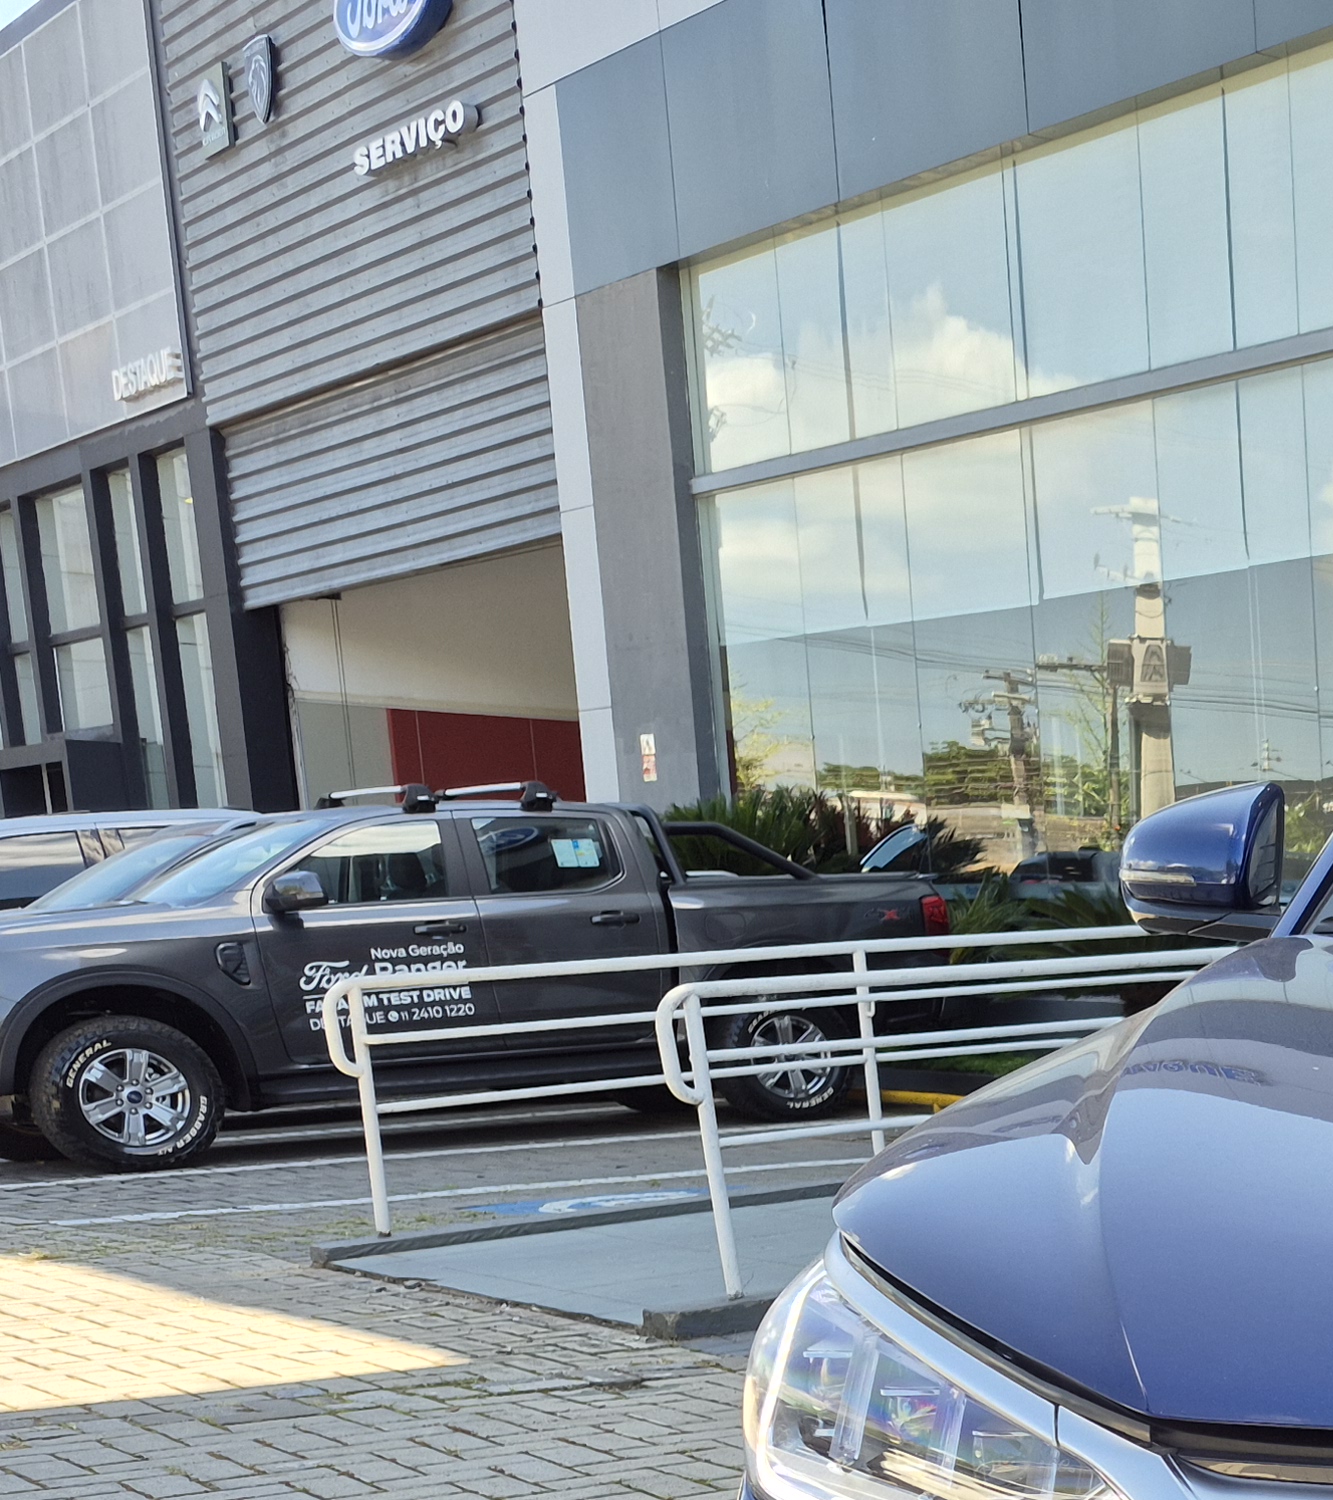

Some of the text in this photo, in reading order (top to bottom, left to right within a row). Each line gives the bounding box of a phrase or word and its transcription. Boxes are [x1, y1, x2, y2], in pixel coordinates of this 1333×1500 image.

[354, 99, 465, 176] SERVIÇO
[112, 346, 182, 401] DESTAQUE
[370, 942, 465, 960] Nova Geração
[305, 996, 350, 1014] FAA
[379, 990, 417, 1006] TEST
[419, 986, 472, 1002] DRIVE
[412, 1008, 442, 1021] 2410
[444, 1003, 475, 1018] 1220
[66, 1039, 112, 1088] GENERAL
